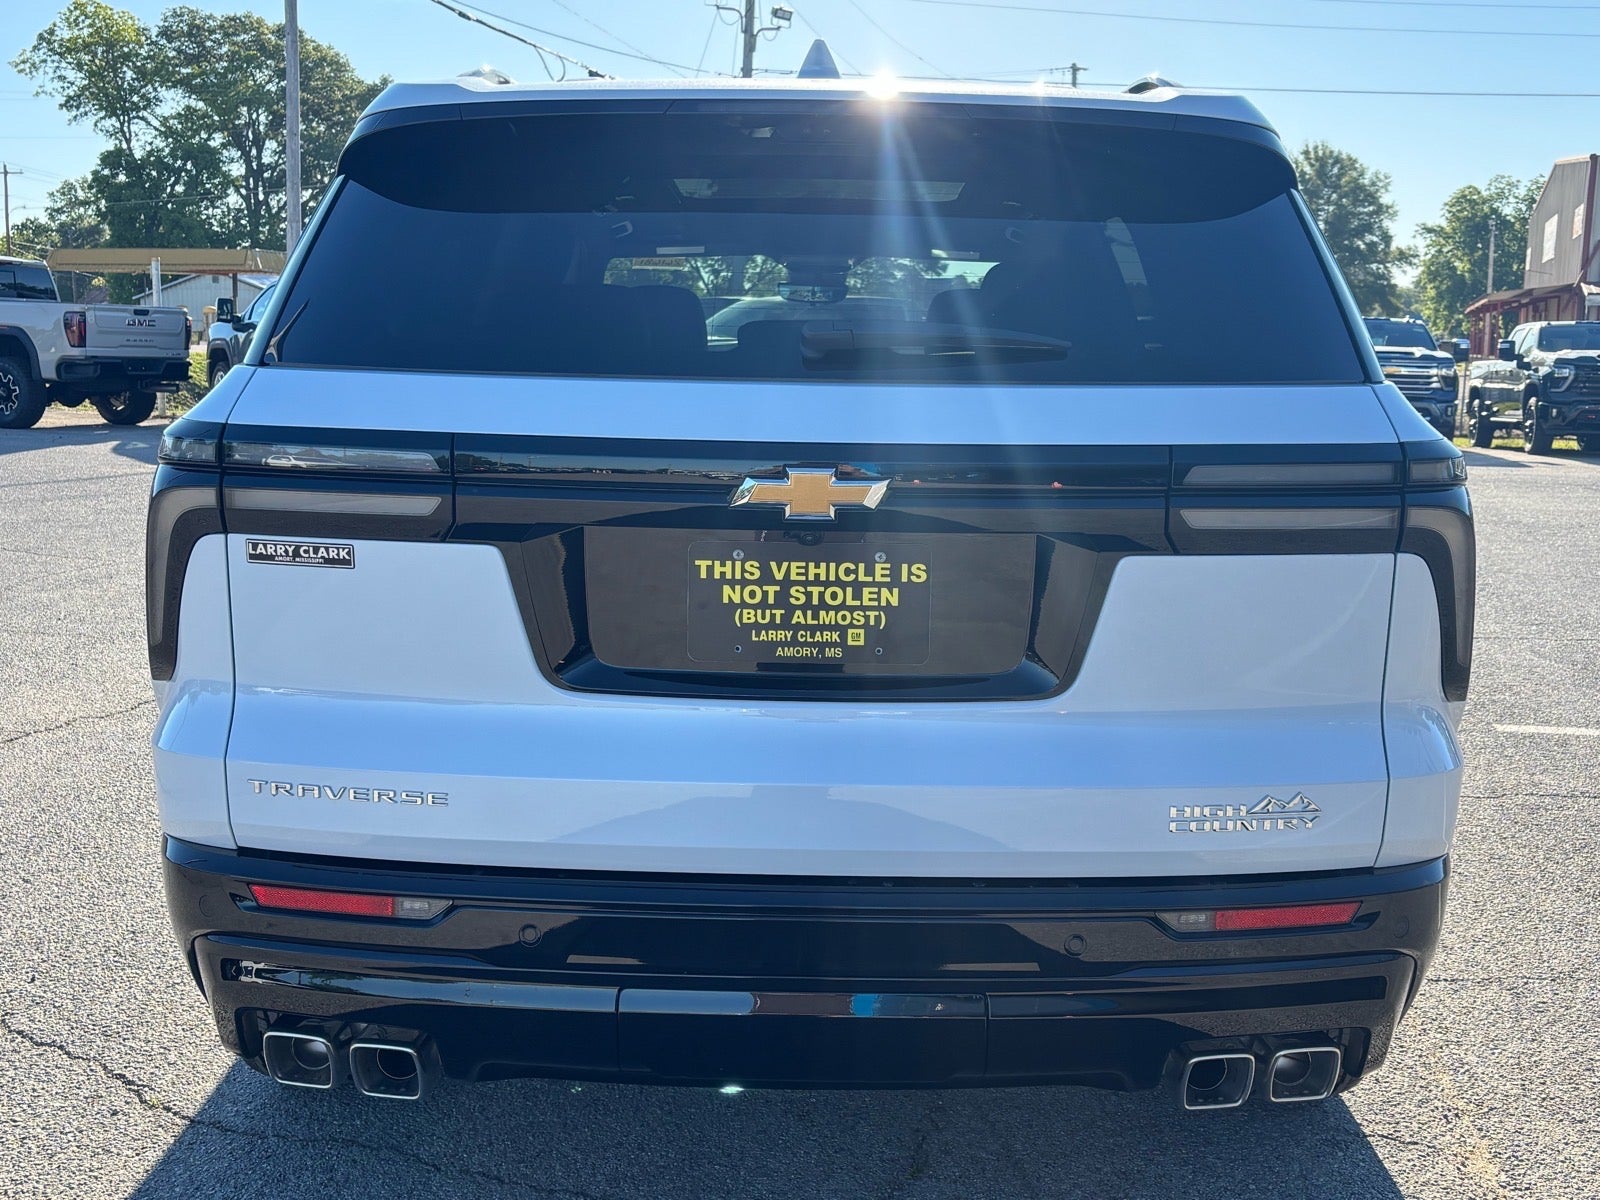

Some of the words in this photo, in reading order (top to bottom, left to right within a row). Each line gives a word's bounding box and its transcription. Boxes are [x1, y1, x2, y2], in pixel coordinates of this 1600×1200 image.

[125, 318, 156, 327] GMC
[248, 542, 296, 557] LARRY
[300, 546, 351, 560] CLARK
[695, 560, 761, 580] THIS
[769, 561, 891, 582] VEHICLE
[901, 563, 928, 583] IS
[722, 584, 780, 605] NOT
[789, 585, 899, 607] STOLEN
[734, 608, 785, 627] (BUT
[791, 610, 887, 630] ALMOST)
[752, 630, 793, 642] LARRY
[798, 631, 841, 643] CLARK
[775, 647, 822, 659] AMORY,
[825, 647, 843, 658] MS
[247, 778, 449, 807] TRAVERSE
[1169, 804, 1247, 818] HIGH
[1168, 815, 1320, 833] COUNTRY
